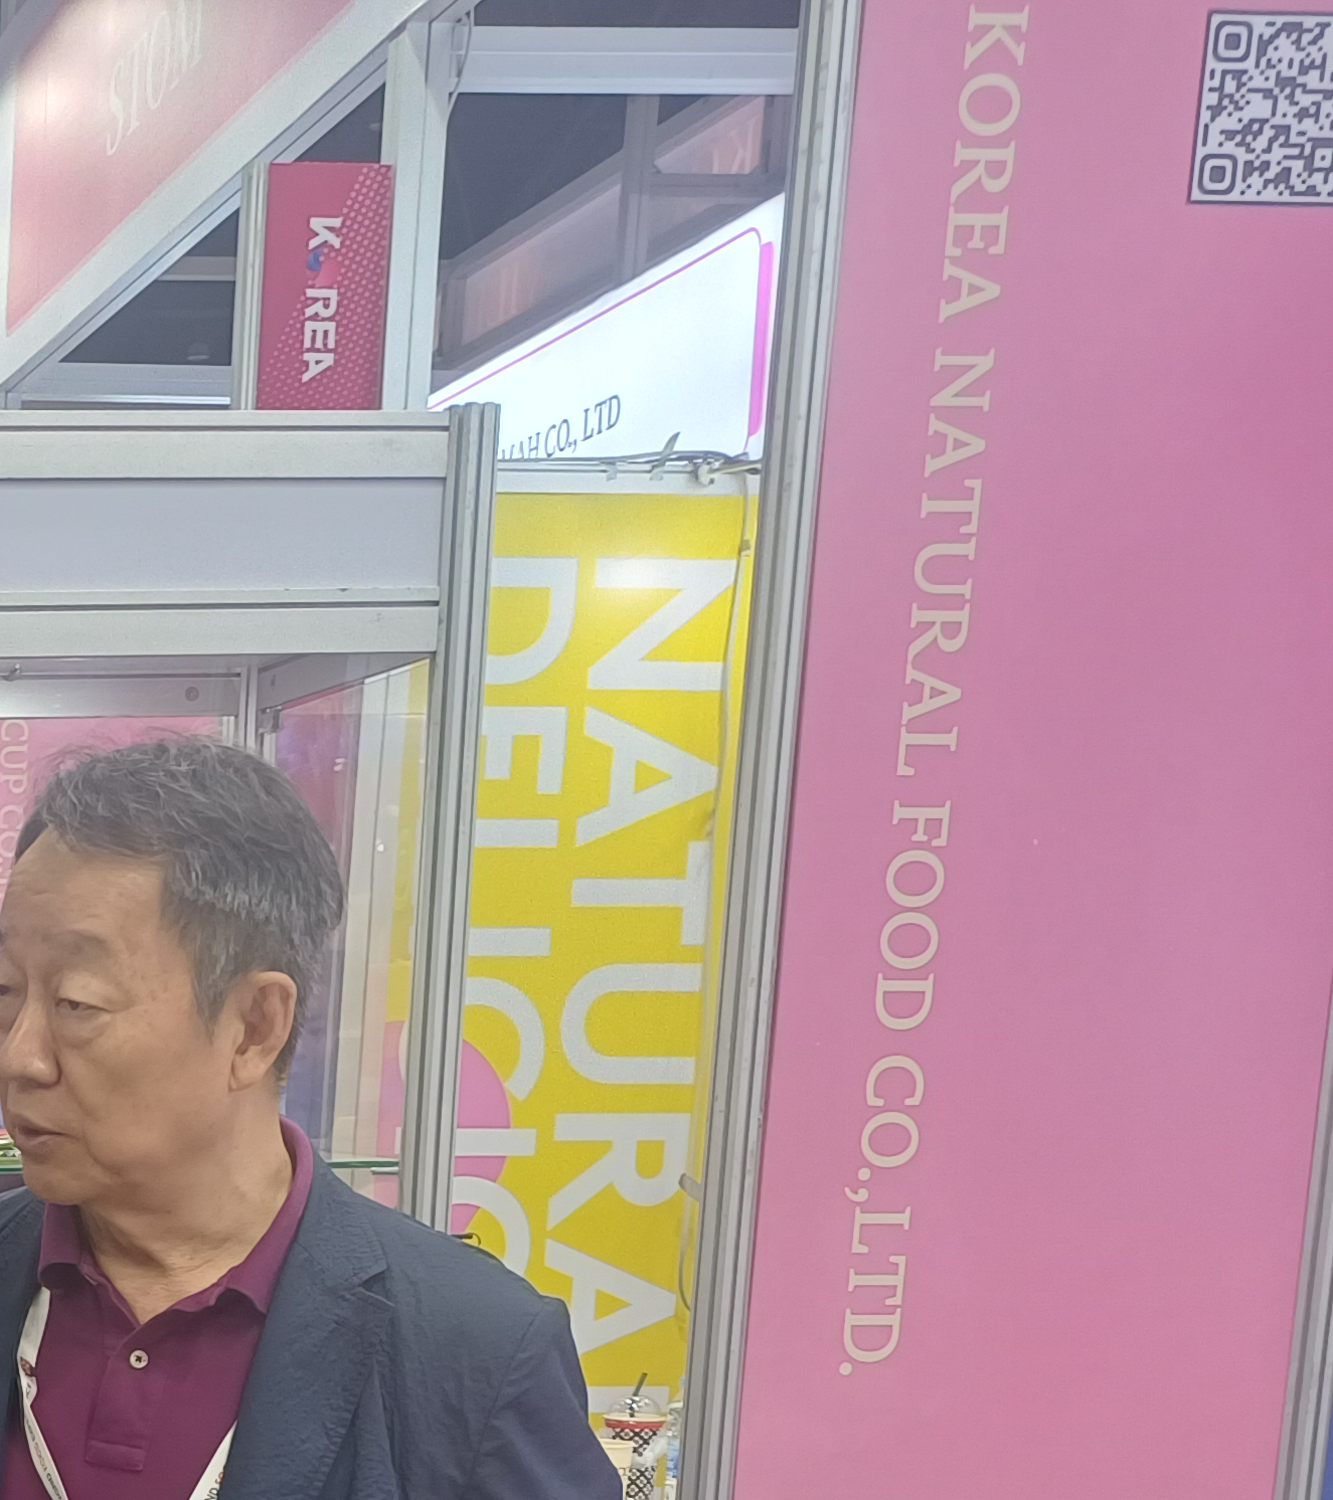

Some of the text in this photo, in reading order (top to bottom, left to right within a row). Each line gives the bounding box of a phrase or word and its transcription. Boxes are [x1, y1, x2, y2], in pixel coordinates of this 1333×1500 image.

[937, 3, 1030, 324] KOREA
[580, 394, 621, 442] LTD
[896, 347, 995, 778] NATURAL
[874, 800, 952, 1031] FOOD
